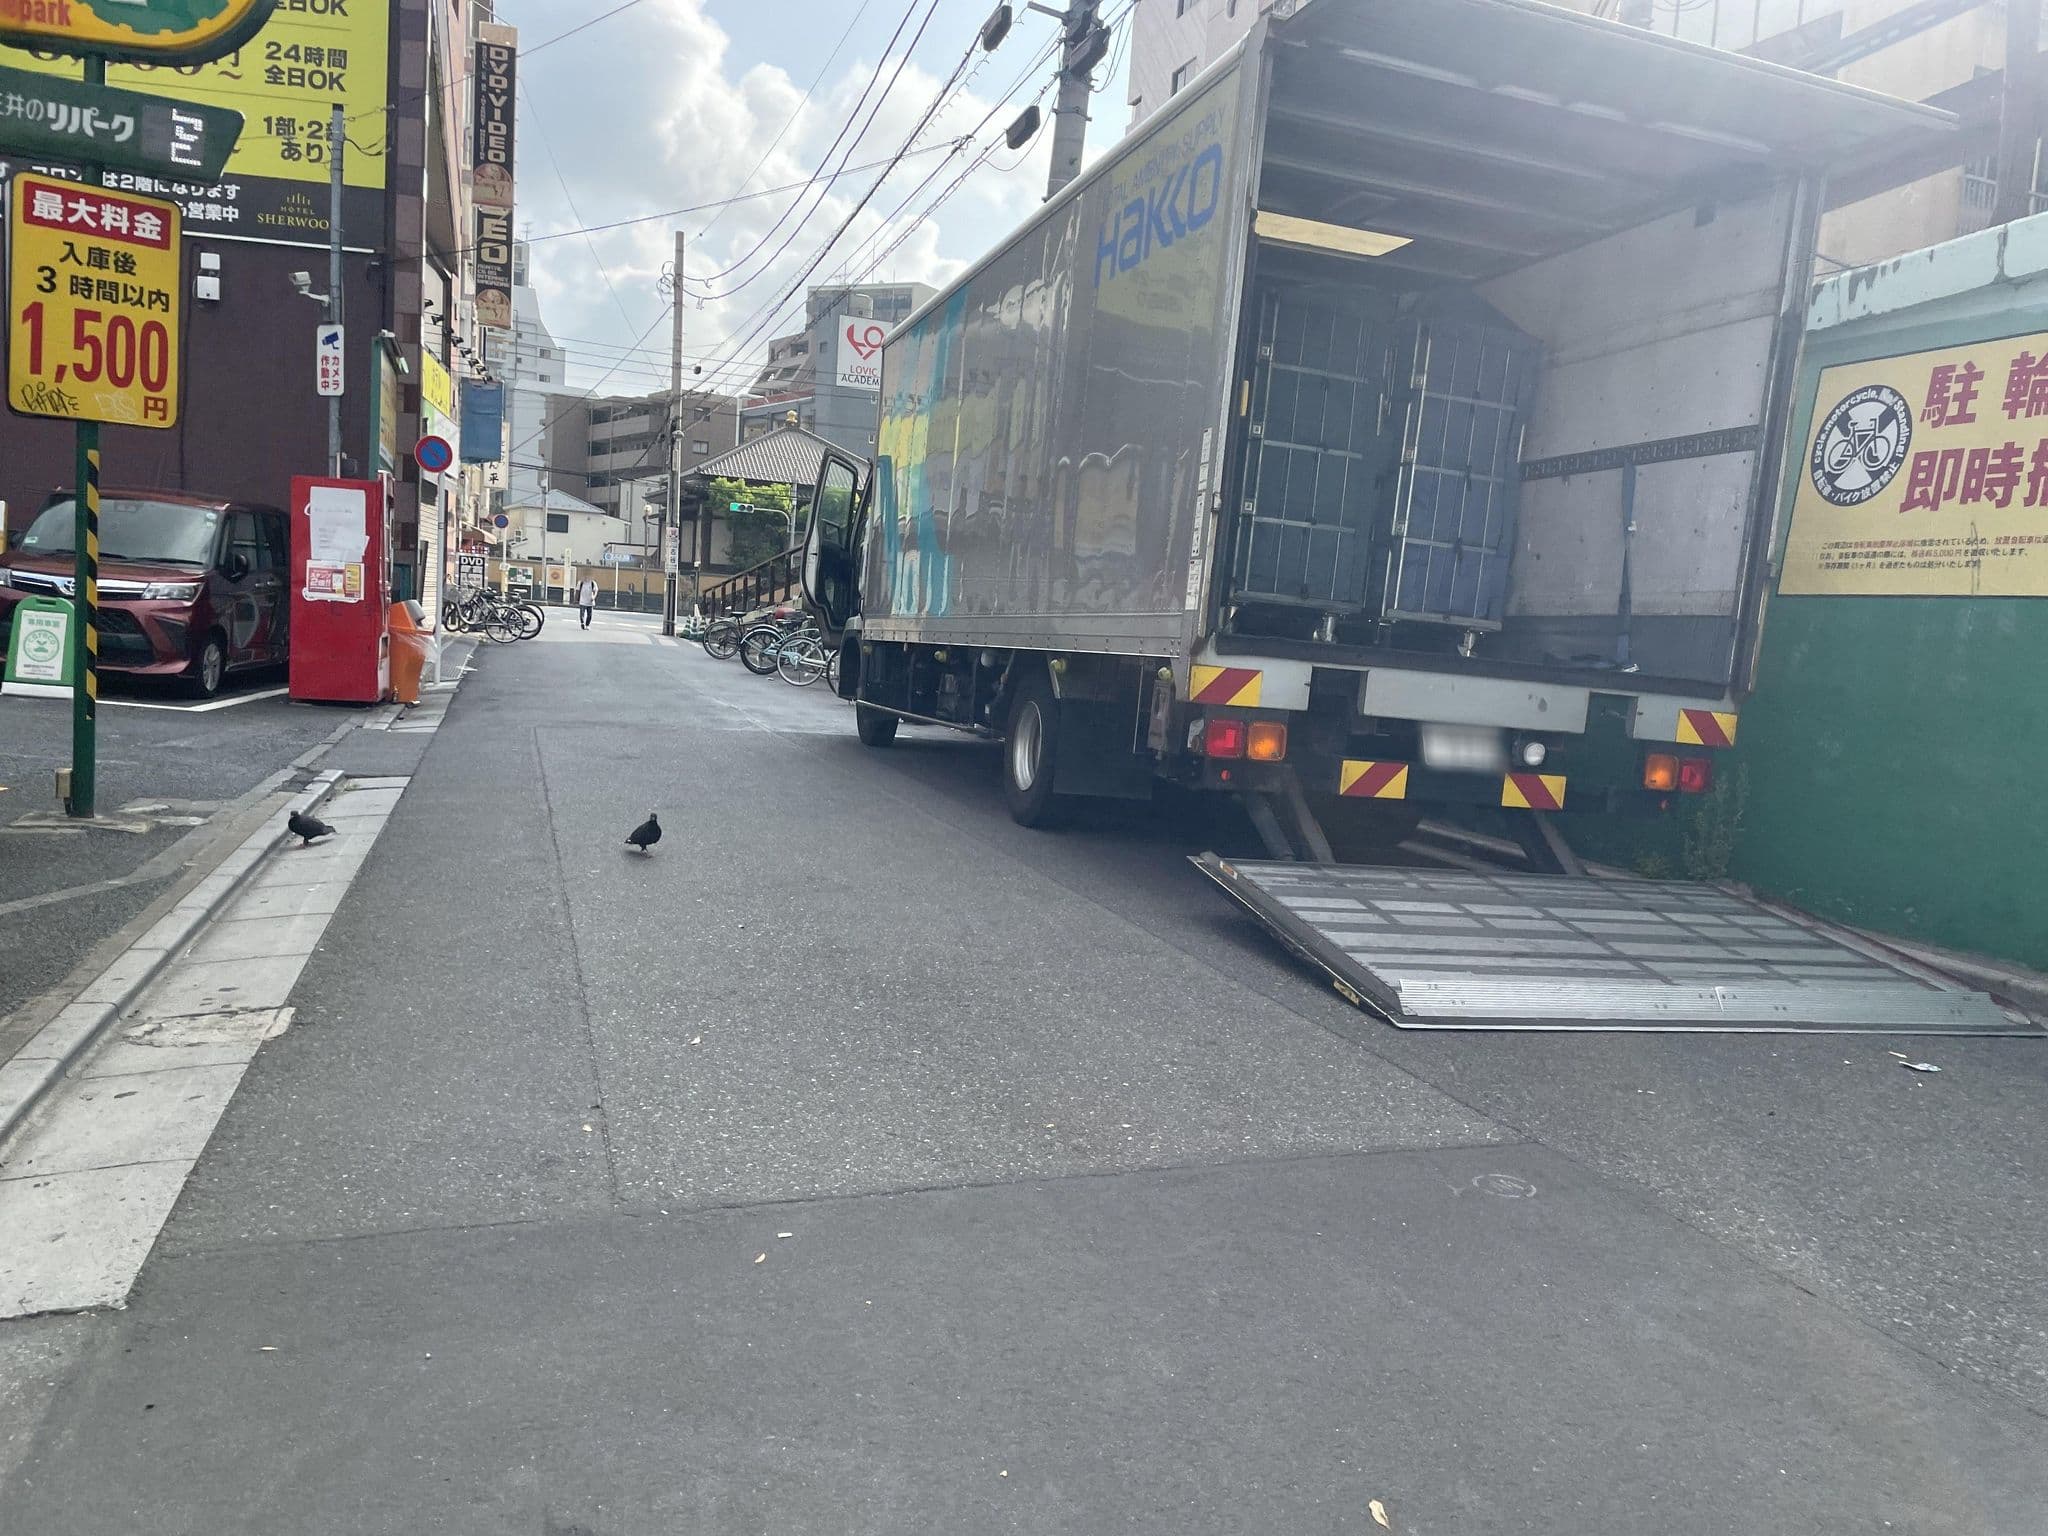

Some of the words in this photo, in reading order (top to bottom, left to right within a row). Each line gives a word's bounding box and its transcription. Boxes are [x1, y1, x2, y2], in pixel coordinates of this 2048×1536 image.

[265, 41, 348, 70] 24時間
[264, 64, 347, 92] 全日OK
[0, 93, 134, 142] 井のリパーク
[281, 140, 323, 163] あり
[33, 190, 162, 241] 最大料金
[257, 213, 330, 230] SHERWOO
[280, 206, 316, 215] HOTEL
[60, 241, 137, 276] 入庫後
[22, 301, 169, 392] 1,500
[320, 354, 330, 391] 作動中
[331, 355, 340, 390] カメラ
[841, 374, 880, 386] ACADEM
[850, 365, 878, 377] LOVIC
[143, 395, 168, 421] 円
[461, 556, 483, 566] DVD
